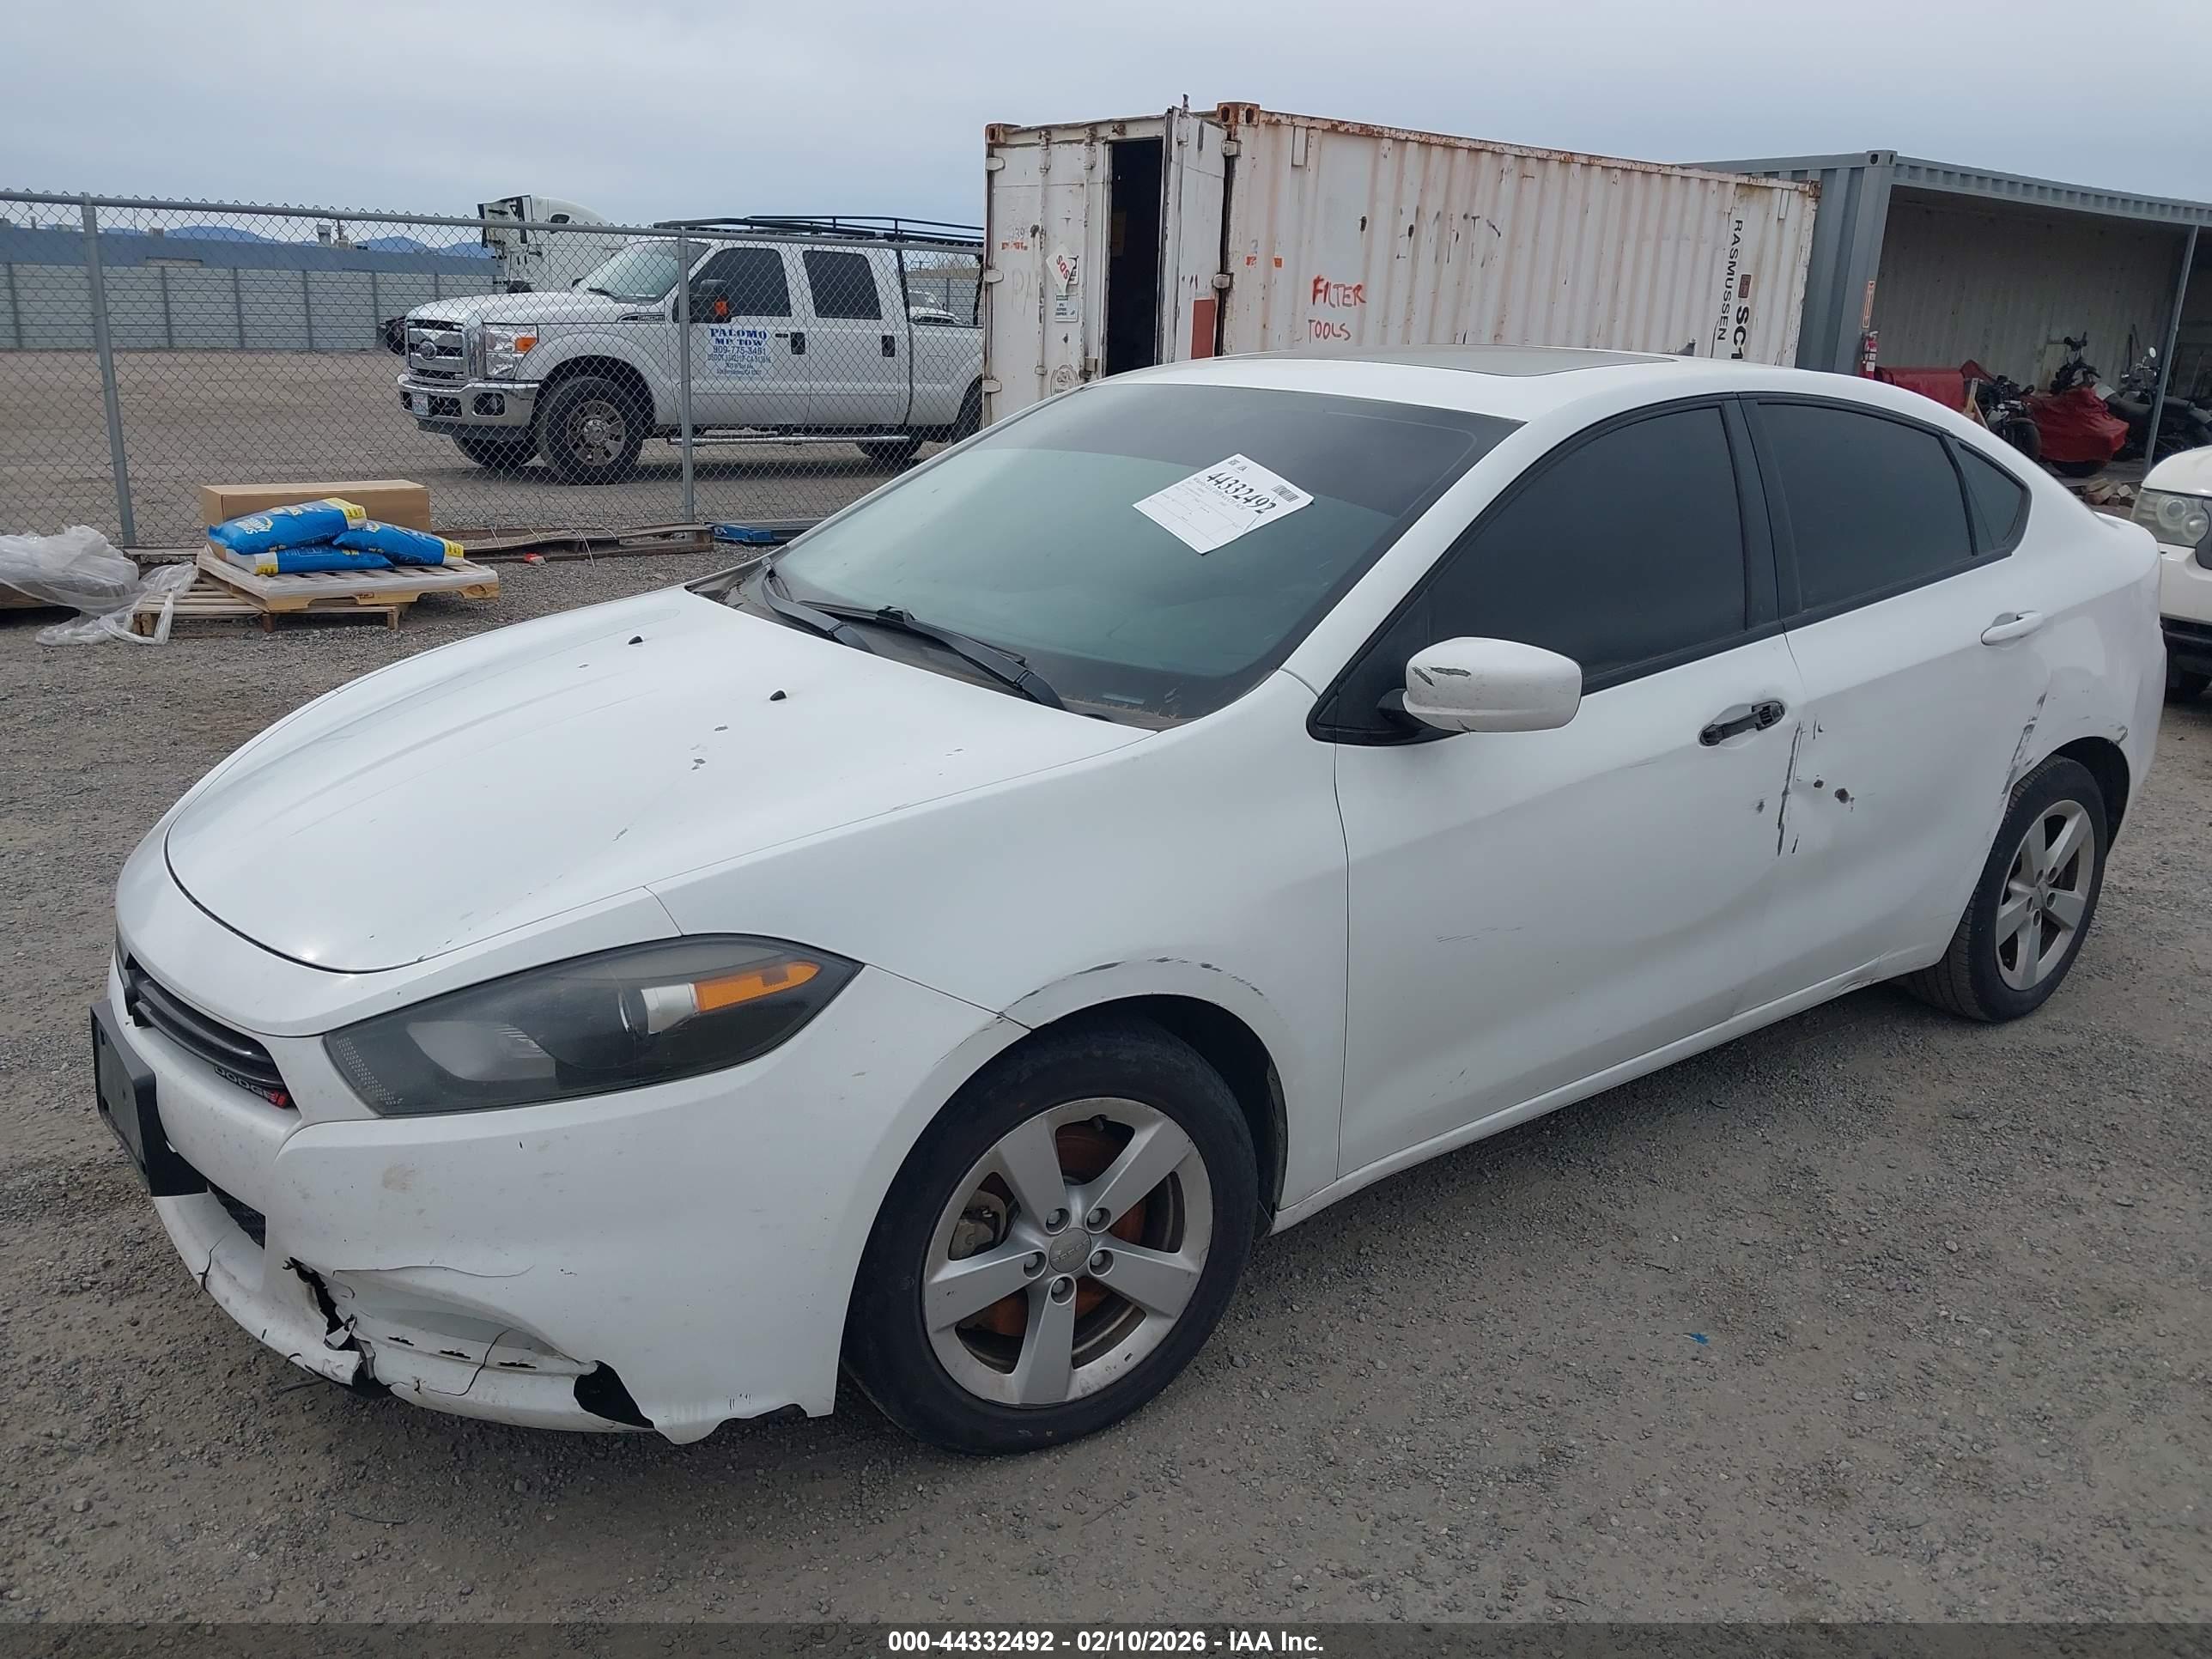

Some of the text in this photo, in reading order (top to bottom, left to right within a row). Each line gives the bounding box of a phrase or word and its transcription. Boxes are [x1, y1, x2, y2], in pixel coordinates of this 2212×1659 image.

[1312, 275, 1367, 308] FILTER
[1717, 220, 1743, 341] RASMUSSEN
[709, 329, 767, 340] PALOMO
[1308, 319, 1352, 343] TOOLS
[1206, 471, 1277, 514] 44332492
[215, 1066, 276, 1102] DODGE
